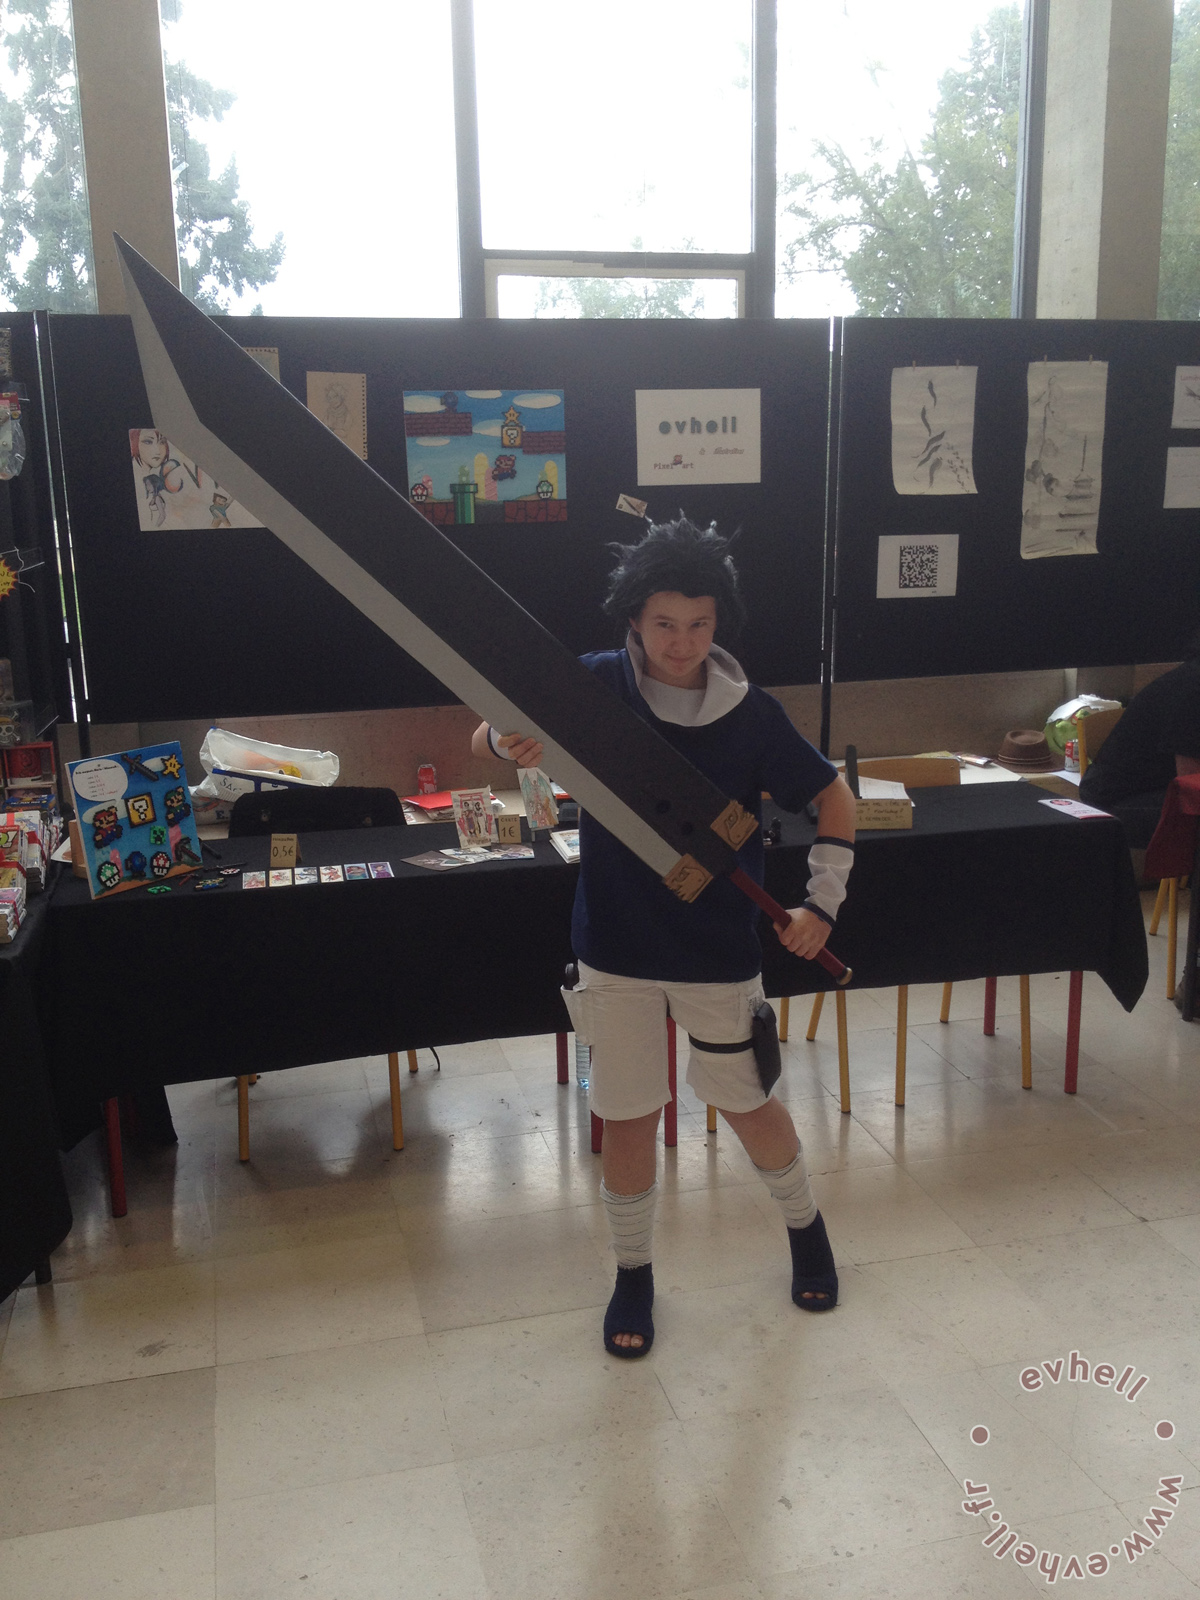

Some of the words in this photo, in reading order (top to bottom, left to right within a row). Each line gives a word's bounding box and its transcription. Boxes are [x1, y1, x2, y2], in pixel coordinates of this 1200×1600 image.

[658, 416, 737, 434] evhell
[501, 825, 515, 838] 1€
[272, 845, 294, 858] 0,5€
